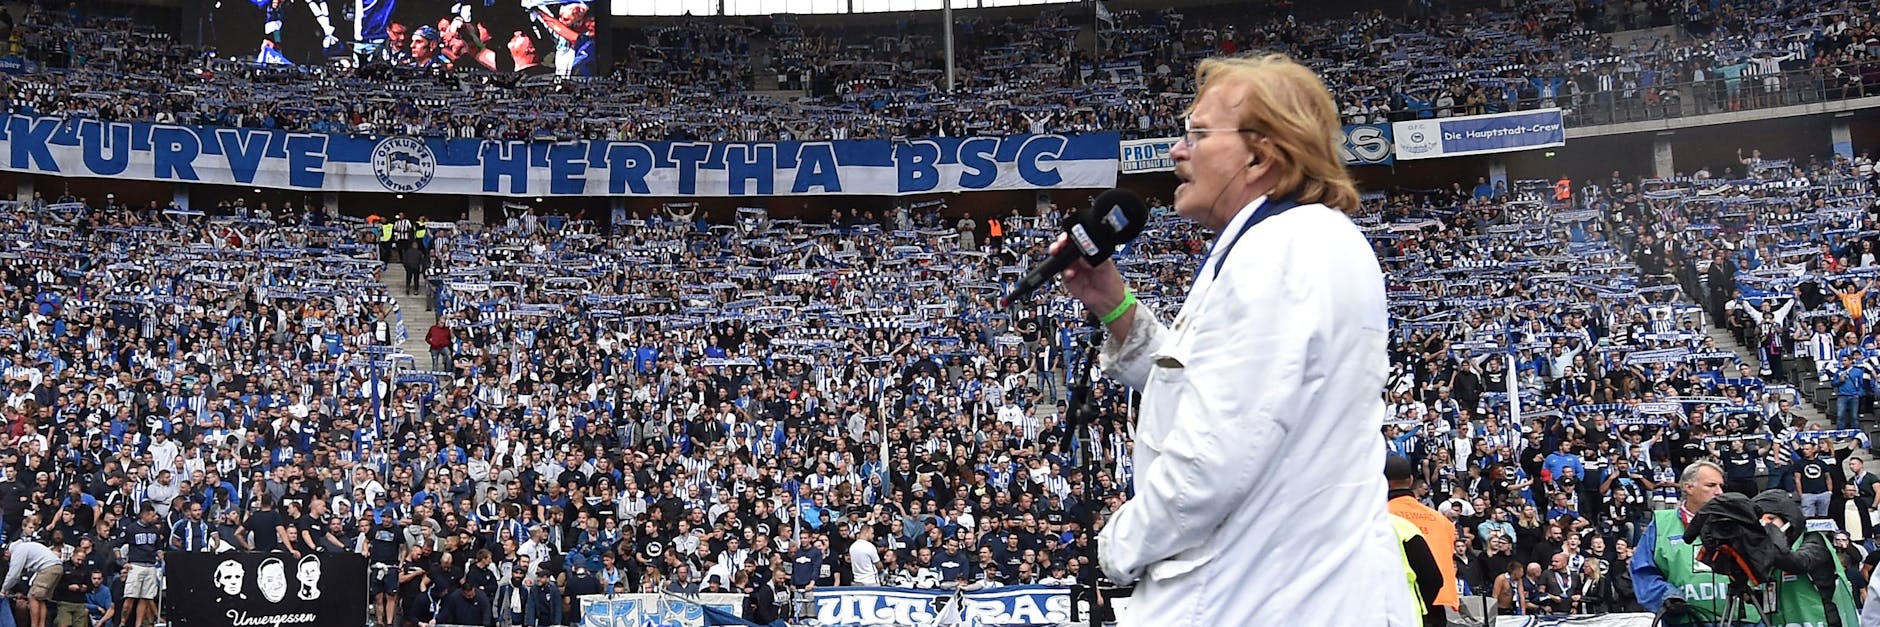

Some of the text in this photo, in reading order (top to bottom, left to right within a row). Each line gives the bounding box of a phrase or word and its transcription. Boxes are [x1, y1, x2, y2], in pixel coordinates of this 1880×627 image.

[1444, 123, 1560, 141] Die Hauptstadt-Crew
[4, 113, 1068, 195] KURVE HERTHA BSC
[1124, 145, 1153, 161] PRO
[377, 169, 413, 191] HERTHA
[226, 609, 316, 627] Unvergessen
